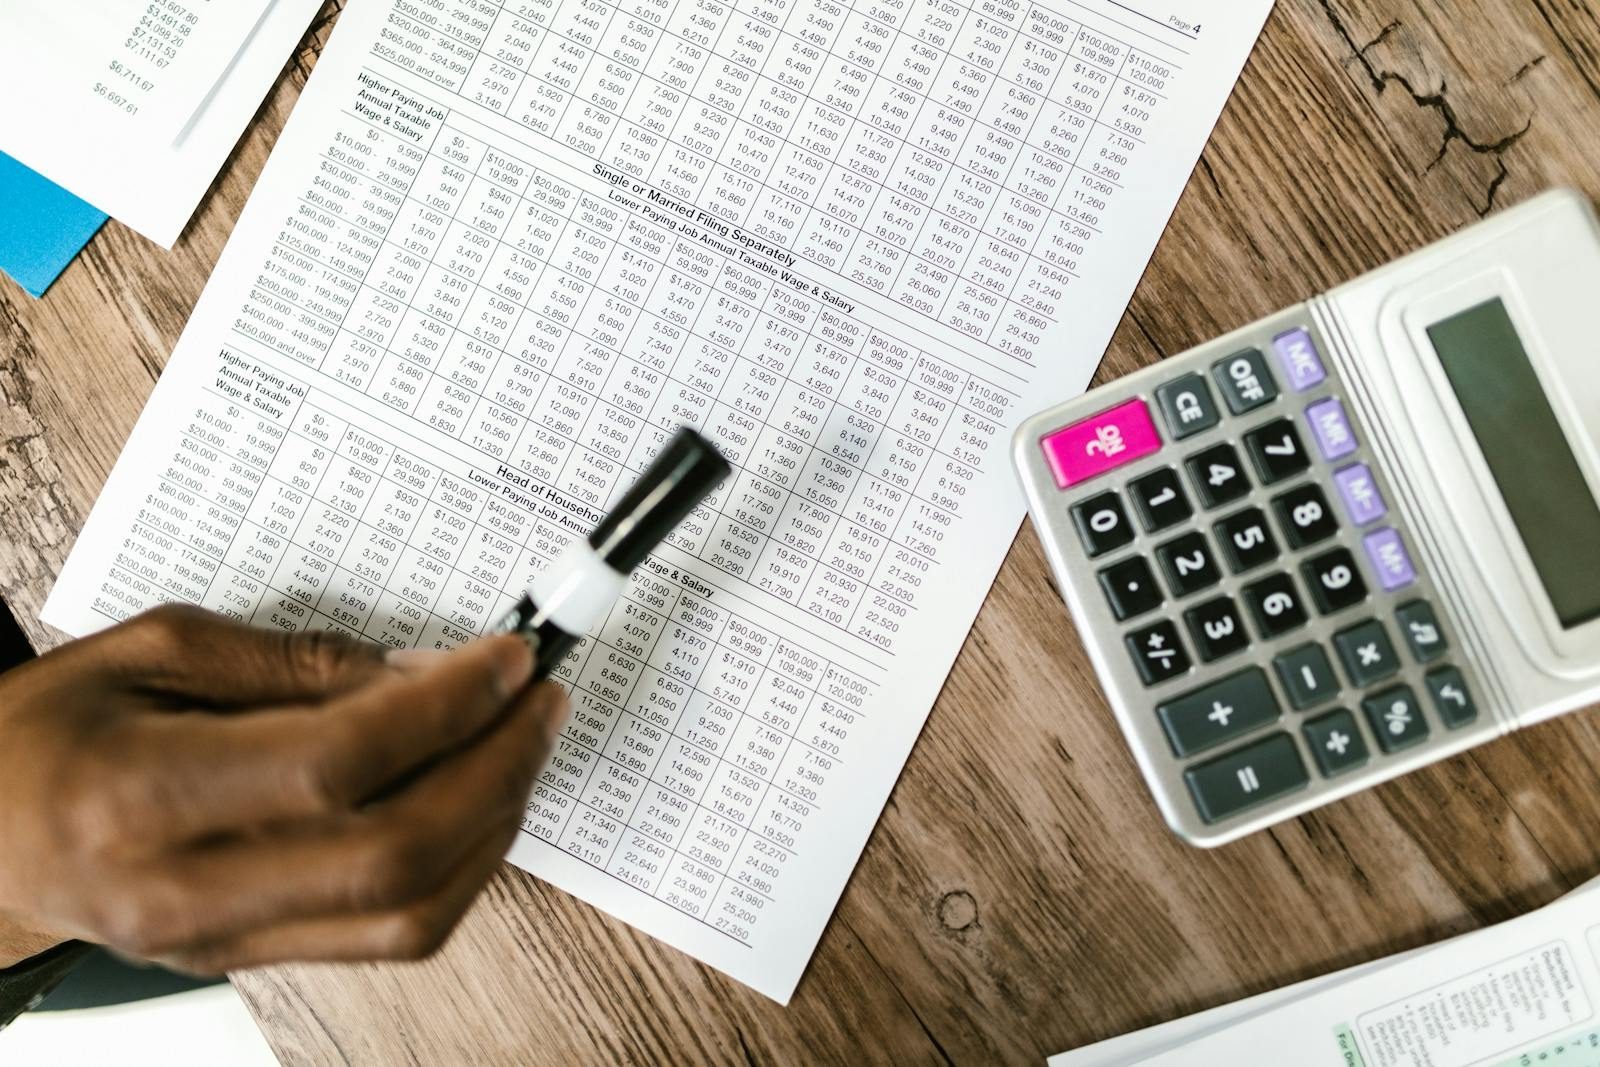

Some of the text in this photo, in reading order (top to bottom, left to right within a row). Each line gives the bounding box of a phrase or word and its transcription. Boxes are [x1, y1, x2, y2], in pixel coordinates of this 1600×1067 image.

[1168, 15, 1202, 34] Page 4
[372, 42, 455, 87] $525,000 and over
[1130, 68, 1165, 90] 120,000
[357, 72, 444, 120] Higher Paying Job
[475, 92, 502, 110] 3,140
[1123, 85, 1156, 106] $1,870
[357, 88, 431, 130] Annual Taxable
[1122, 104, 1149, 121] 4,070
[354, 100, 423, 142] Wage & Salary
[522, 114, 548, 132] 6,840
[1114, 118, 1142, 136] 5,930
[565, 134, 595, 154] 10,200
[1107, 132, 1134, 151] 7,130
[441, 165, 465, 182] $440
[612, 156, 643, 176] 12,900
[1092, 162, 1120, 180] 9,260
[488, 187, 512, 205] $940
[660, 178, 690, 199] 15,530
[1074, 190, 1106, 210] 11,260
[527, 206, 559, 227] $1,020
[592, 163, 797, 267] Single or Married Filing Separately
[708, 201, 738, 221] 18,030
[574, 228, 606, 250] $1,020
[754, 223, 787, 244] 20,530
[1059, 220, 1091, 240] 15,290
[608, 189, 855, 314] Lower Paying Job Annual Taxable Wage & Salary
[621, 251, 654, 272] $1,410
[802, 246, 836, 267] 23,030
[1044, 250, 1076, 270] 18,040
[669, 274, 702, 295] $1,870
[851, 269, 884, 290] 25,530
[1037, 264, 1069, 285] 19,640
[717, 297, 750, 318] $1,870
[900, 292, 933, 313] 28,030
[1020, 294, 1055, 315] 22,840
[949, 315, 982, 336] 30,300
[1013, 309, 1047, 330] 26,860
[234, 318, 316, 364] $450,000 and over
[766, 320, 799, 341] $1,870
[814, 343, 848, 364] $1,870
[999, 339, 1032, 360] 31,800
[1287, 342, 1316, 377] MC
[218, 348, 304, 398] Higher Paying Job
[335, 368, 362, 386] 3,140
[863, 366, 896, 388] $2,030
[1229, 360, 1264, 400] OFF
[218, 365, 291, 406] Annual Taxable
[215, 377, 283, 419] Wage & Salary
[382, 392, 408, 410] 6,250
[912, 390, 946, 412] $2,040
[1175, 392, 1202, 423] CE
[429, 415, 456, 433] 8,830
[962, 413, 996, 435] $2,040
[1319, 412, 1346, 445] MR
[472, 436, 503, 456] 11,330
[1101, 424, 1127, 456] ON
[1265, 435, 1295, 455] 7
[347, 466, 372, 484] $820
[520, 459, 551, 480] 13,830
[1208, 464, 1235, 486] 4
[339, 480, 364, 498] 1,900
[496, 464, 604, 526] Head of Househol
[568, 482, 598, 503] 15,790
[1149, 488, 1175, 506] 1
[467, 469, 593, 540] Lower Paying Job Annua
[1293, 502, 1322, 526] 8
[1090, 510, 1118, 532] 0
[1234, 526, 1264, 550] 5
[301, 554, 327, 572] 4,280
[710, 553, 744, 575] 20,290
[1175, 551, 1204, 576] 2
[1378, 543, 1402, 574] M+
[670, 570, 679, 581] &
[680, 574, 714, 598] Salary
[759, 577, 793, 599] 21,790
[1321, 566, 1351, 589] 9
[286, 584, 312, 603] 4,440
[808, 601, 842, 623] 23,100
[1263, 593, 1292, 616] 6
[858, 626, 892, 648] 24,400
[1204, 616, 1233, 640] 3
[673, 628, 706, 651] $1,870
[672, 647, 699, 666] 4,110
[664, 662, 692, 681] 5,540
[657, 677, 684, 696] 6,830
[649, 692, 676, 711] 9,050
[638, 705, 669, 726] 11,050
[1384, 701, 1411, 734] %
[630, 720, 661, 742] 11,590
[623, 735, 654, 757] 13,690
[615, 750, 646, 772] 15,890
[608, 766, 639, 787] 18,640
[598, 780, 632, 803] 20,390
[590, 796, 624, 818] 21,340
[568, 841, 601, 864] 23,110
[666, 893, 699, 914] 26,050
[1337, 1033, 1349, 1050] For
[1520, 1053, 1531, 1066] 10
